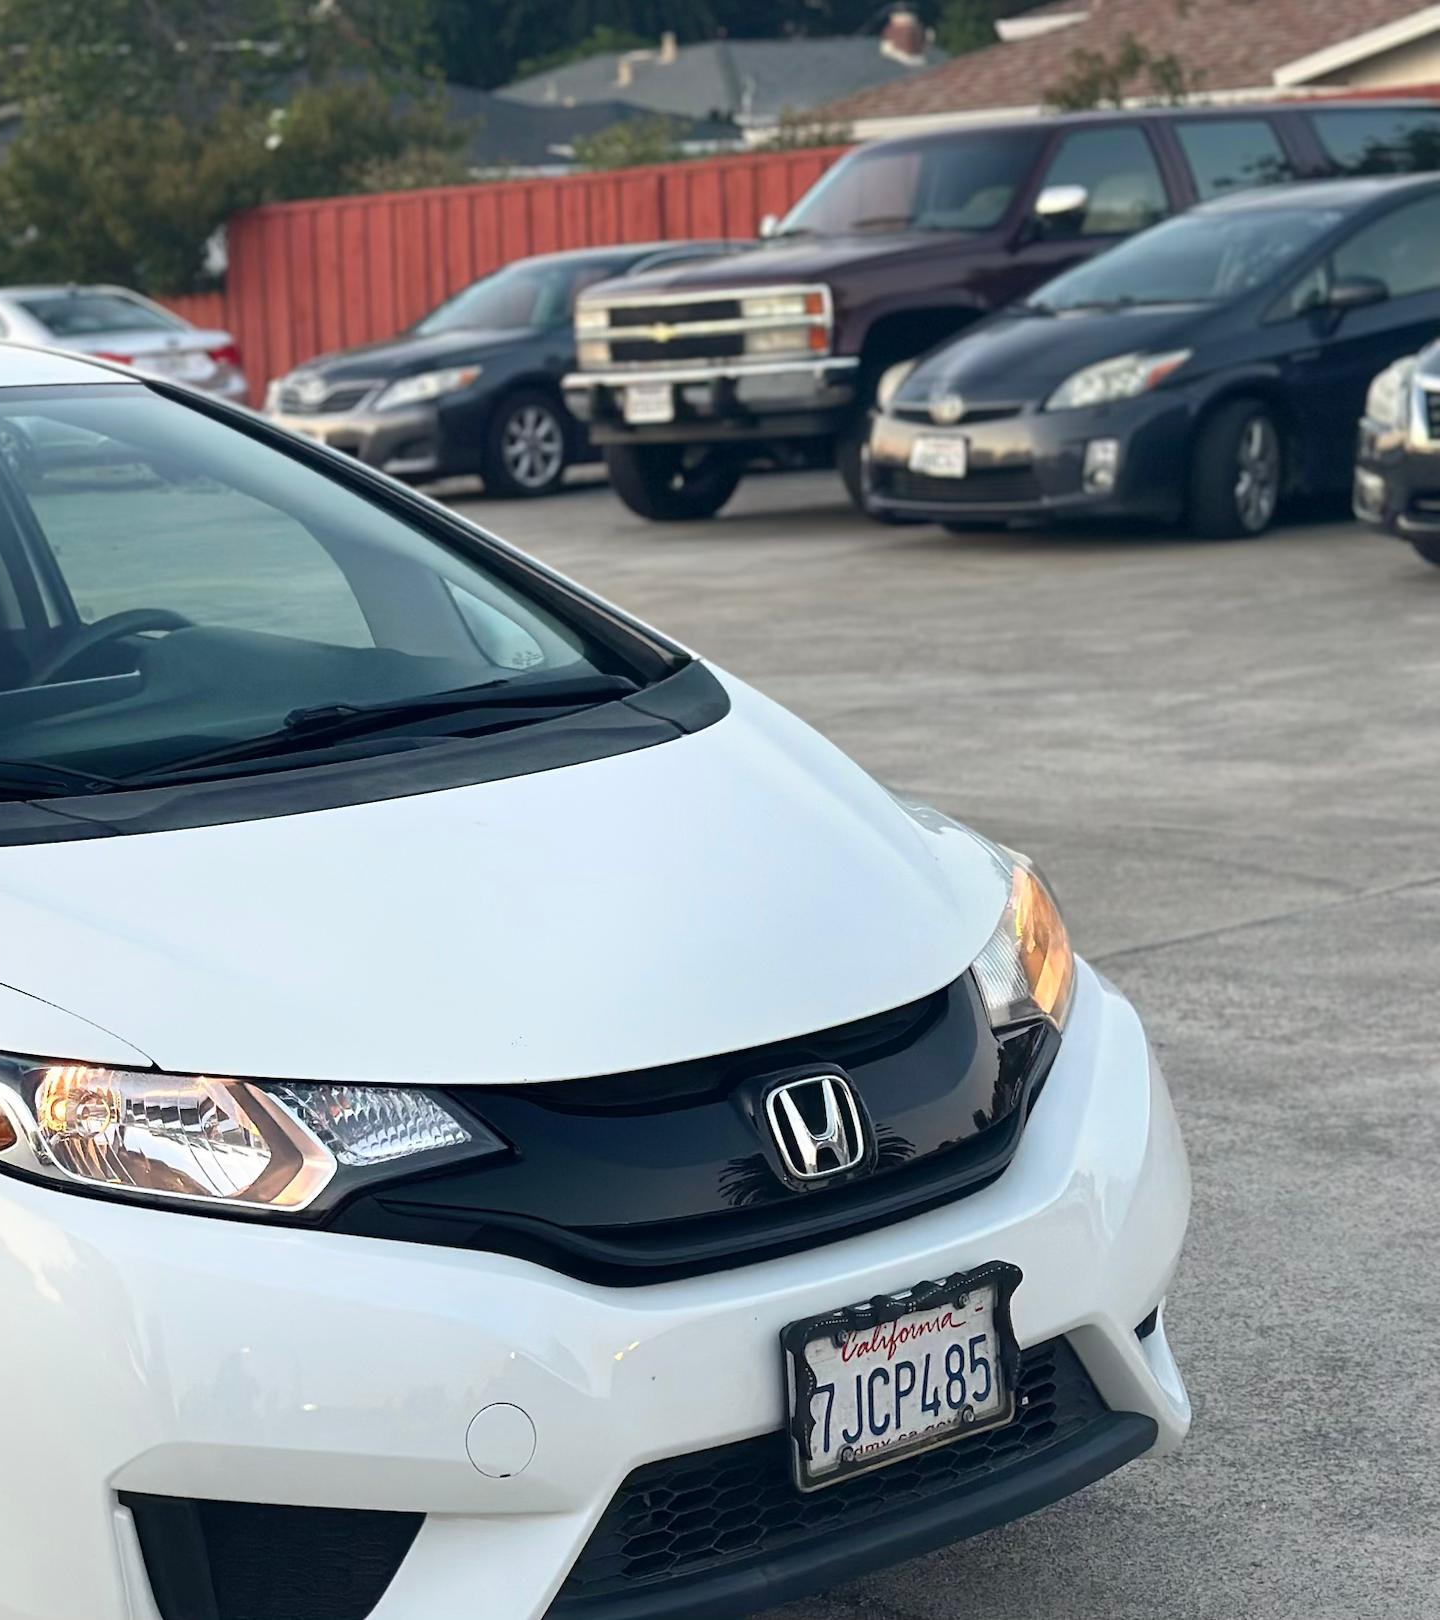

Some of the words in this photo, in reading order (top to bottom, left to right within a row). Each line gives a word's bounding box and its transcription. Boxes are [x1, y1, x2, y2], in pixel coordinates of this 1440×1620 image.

[841, 1311, 966, 1362] California
[812, 1333, 992, 1453] 7JCP485
[854, 1420, 956, 1456] dmvcao
